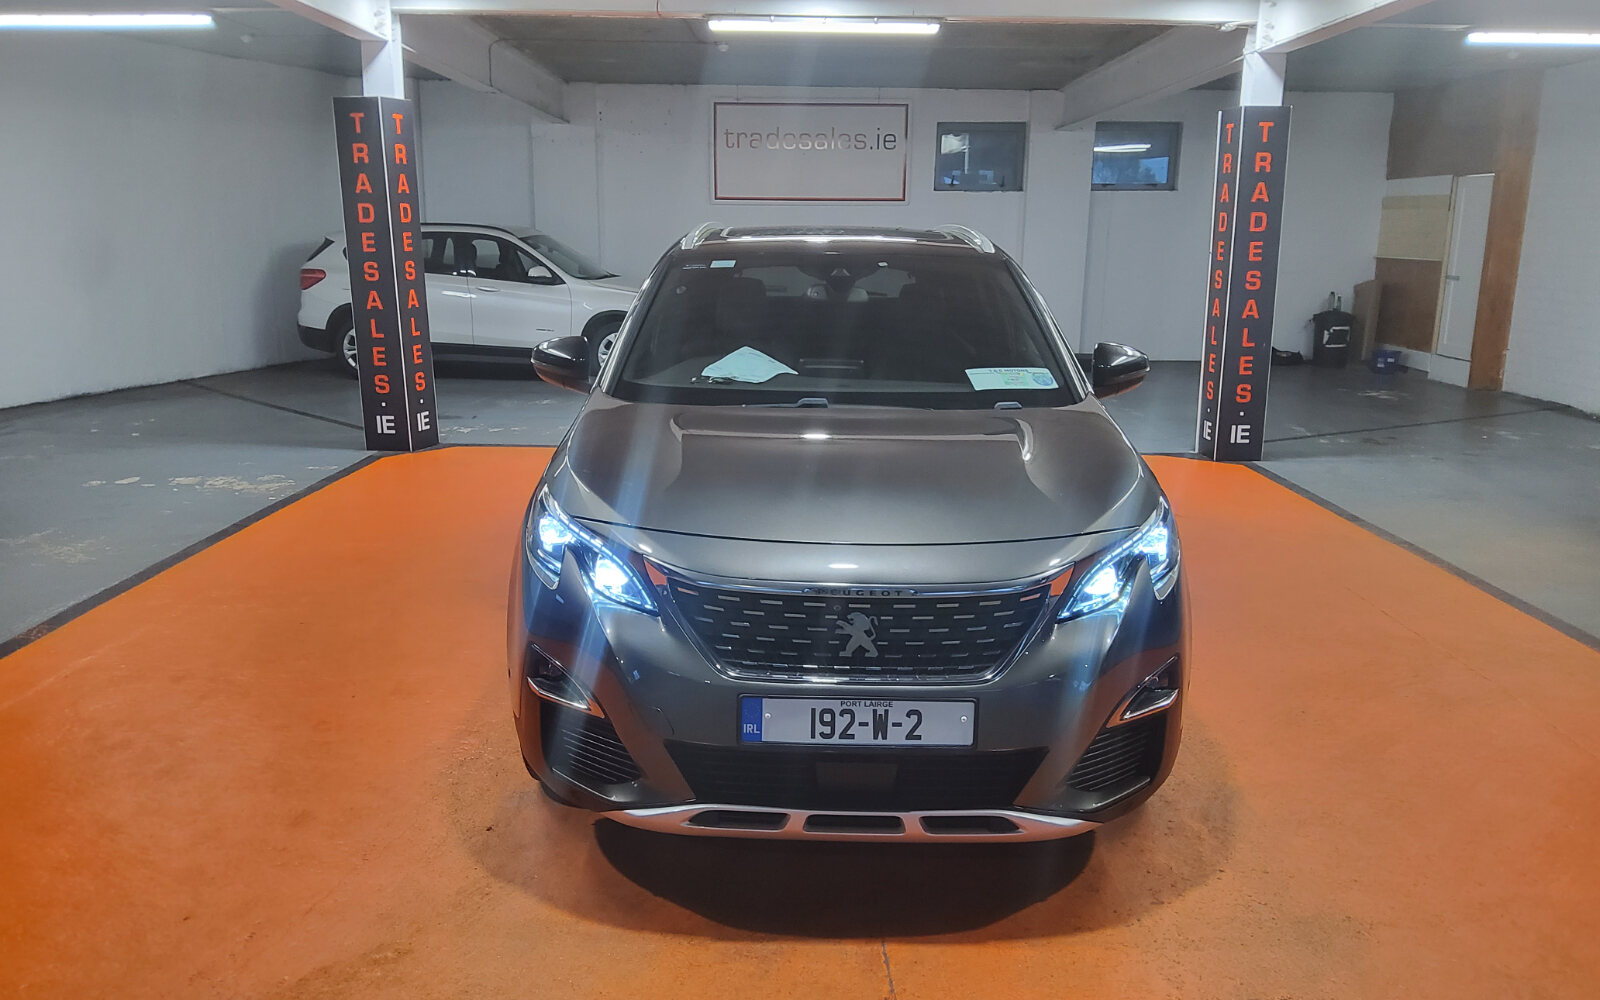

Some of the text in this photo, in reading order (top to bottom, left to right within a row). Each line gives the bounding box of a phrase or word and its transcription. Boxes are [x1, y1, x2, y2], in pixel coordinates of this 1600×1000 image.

[724, 126, 897, 151] tradesales.ie
[815, 589, 903, 597] PEUGEOT
[840, 700, 861, 708] PORT
[743, 723, 760, 734] IRL
[810, 707, 923, 741] 192-W-2
